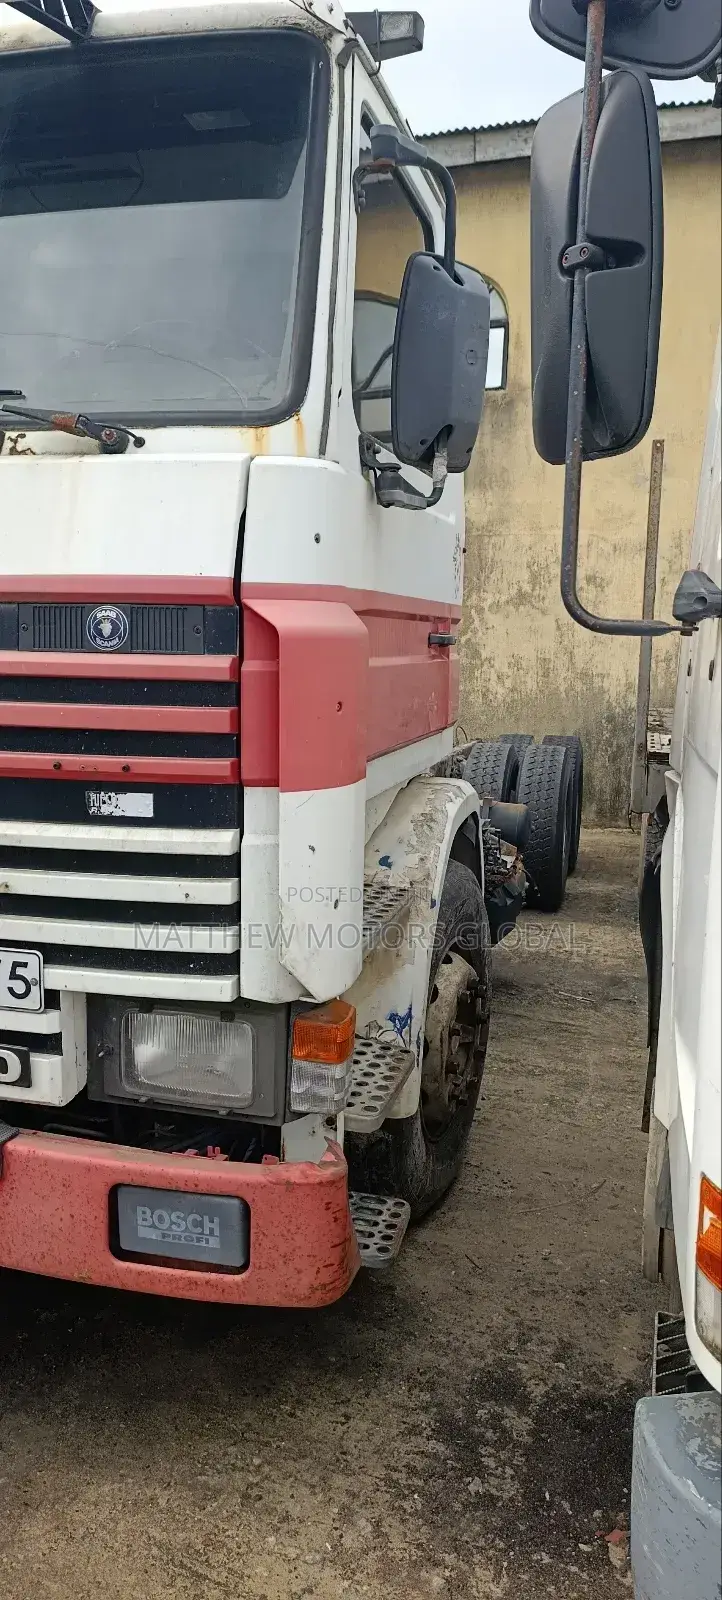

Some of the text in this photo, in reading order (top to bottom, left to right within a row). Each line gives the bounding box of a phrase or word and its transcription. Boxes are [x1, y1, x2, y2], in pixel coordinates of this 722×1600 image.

[97, 610, 117, 618] SAAB
[95, 636, 119, 648] SCANIA
[0, 960, 32, 1000] 5
[136, 1206, 220, 1236] BOSCH
[161, 1232, 210, 1244] PROFI
